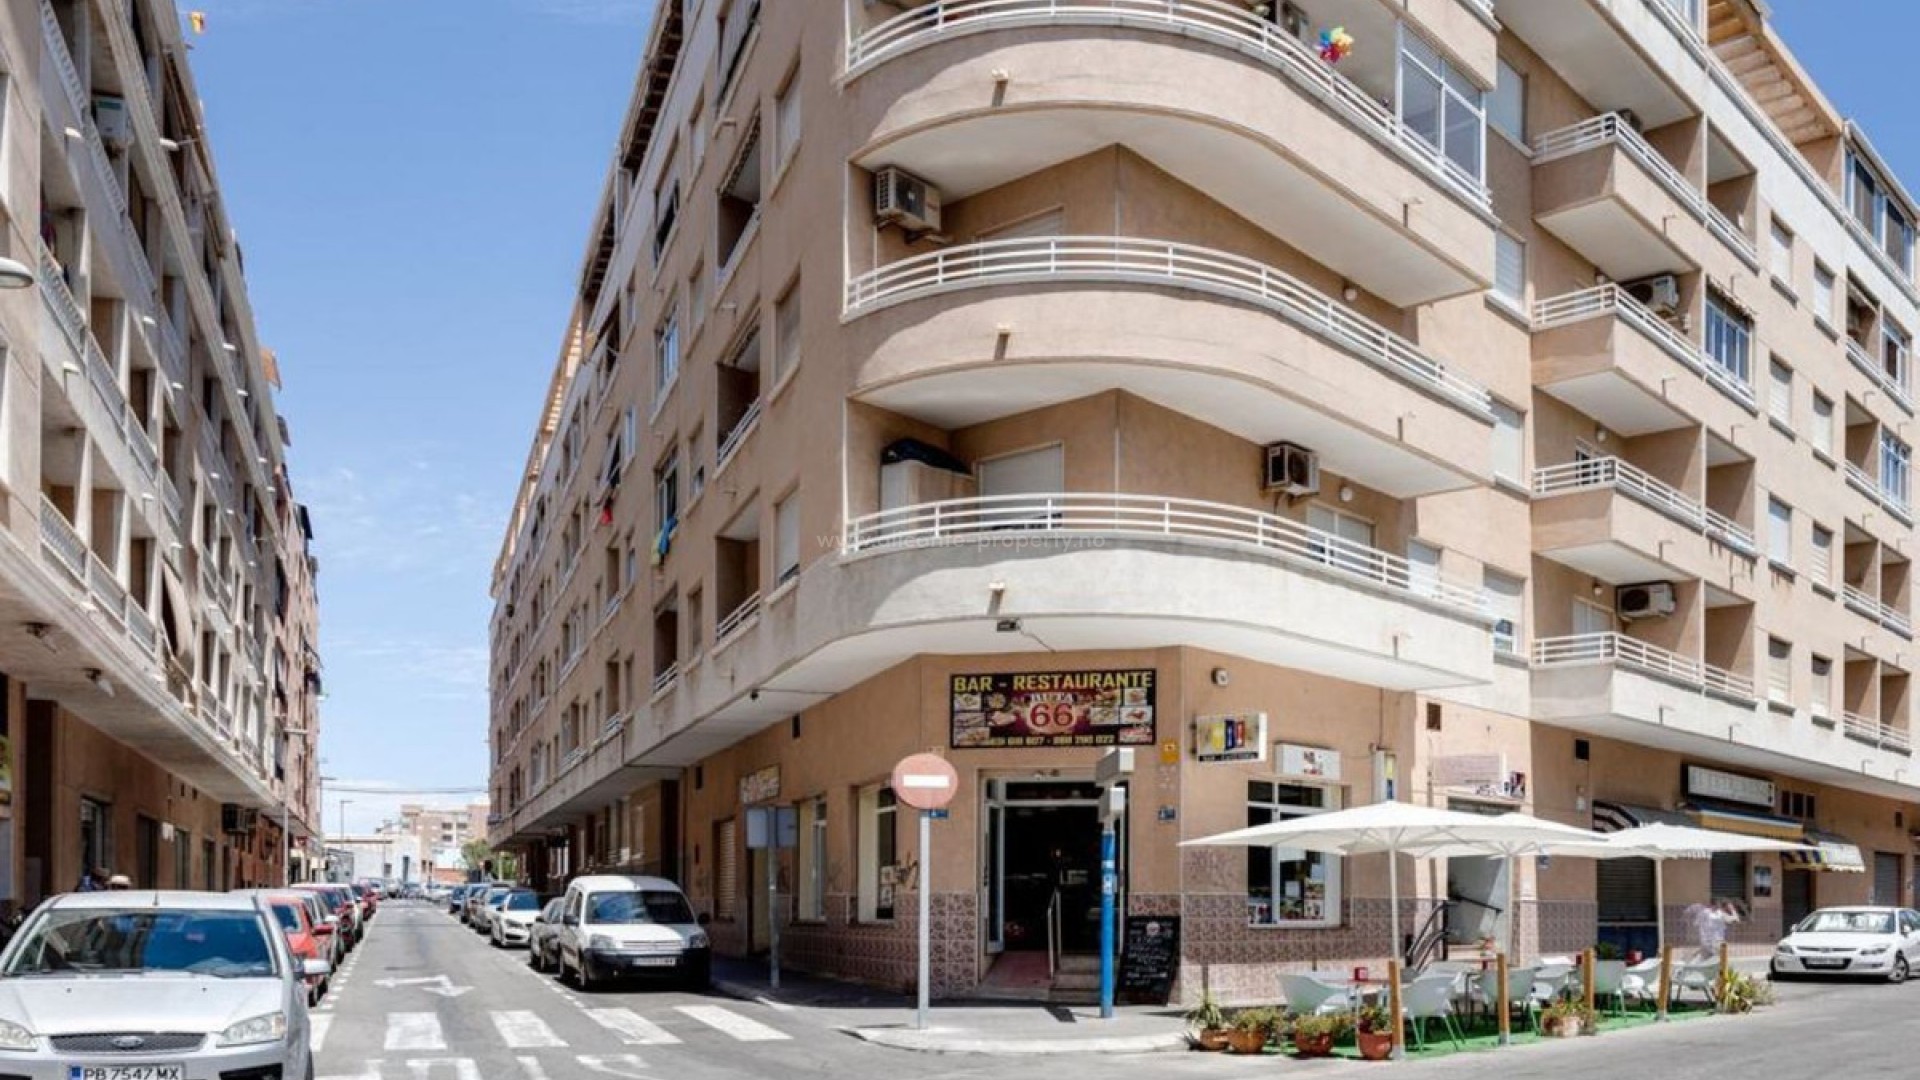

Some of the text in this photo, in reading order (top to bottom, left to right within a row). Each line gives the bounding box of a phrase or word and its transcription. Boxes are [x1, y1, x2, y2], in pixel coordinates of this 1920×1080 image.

[953, 676, 993, 692] BAR
[1012, 672, 1153, 690] RESTAURANTE
[1029, 703, 1073, 728] 66
